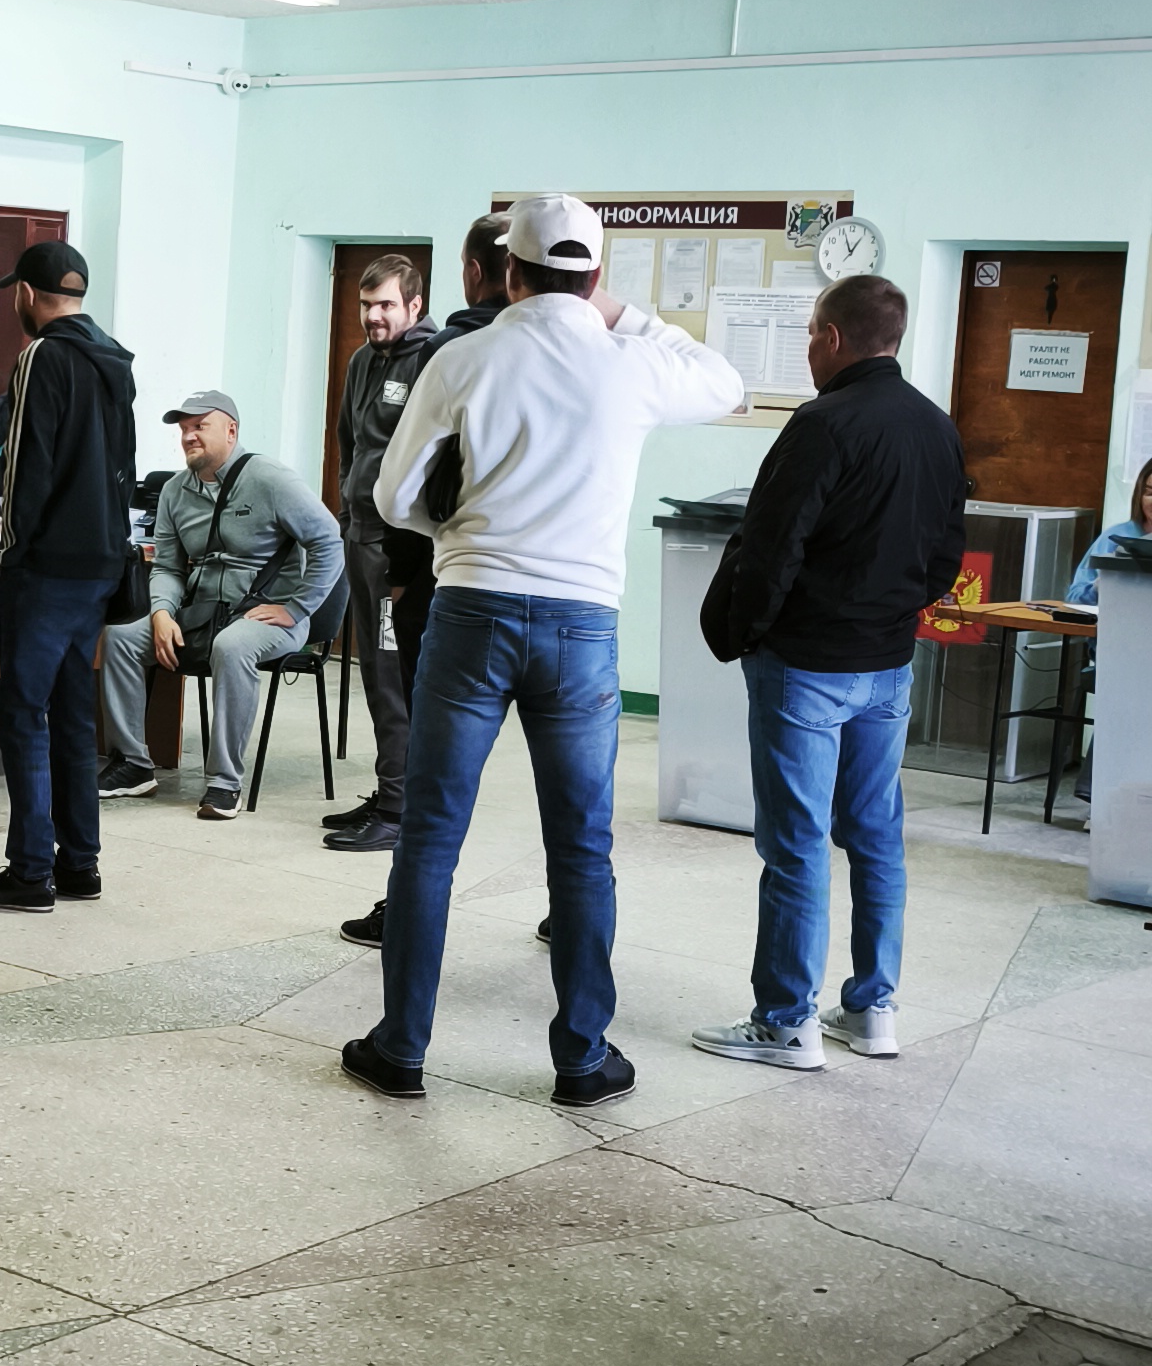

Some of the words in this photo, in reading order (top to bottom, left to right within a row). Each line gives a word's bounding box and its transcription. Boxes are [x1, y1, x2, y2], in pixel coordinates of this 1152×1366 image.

[849, 225, 856, 233] 12
[828, 237, 837, 245] 10
[870, 236, 876, 244] 2
[824, 249, 830, 258] 9
[873, 249, 879, 258] 3
[826, 262, 832, 270] 8
[868, 261, 874, 269] 4
[835, 270, 841, 279] 7
[1029, 345, 1059, 354] ТУАЛЕТ
[1060, 346, 1071, 354] НЕ
[1028, 357, 1069, 366] РАБОТАЕТ
[1019, 369, 1040, 379] ИДЕТ
[1042, 370, 1076, 380] РЕМОНТ
